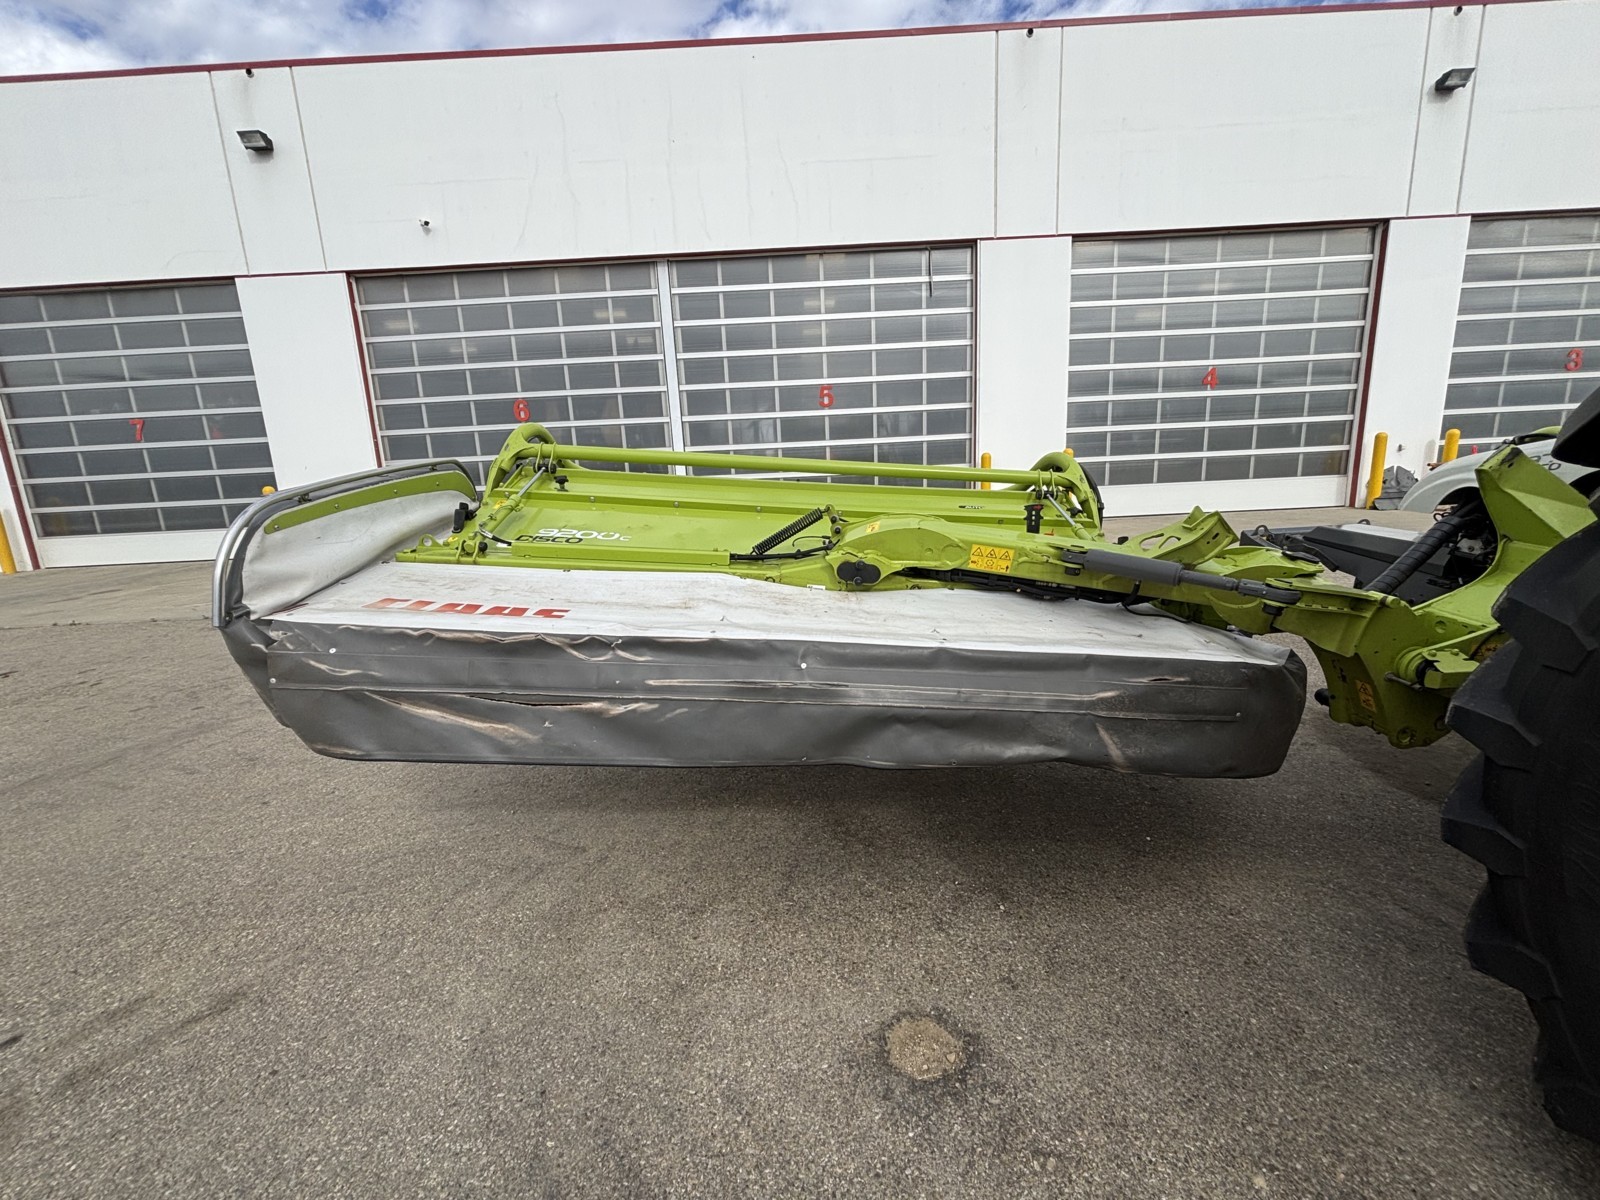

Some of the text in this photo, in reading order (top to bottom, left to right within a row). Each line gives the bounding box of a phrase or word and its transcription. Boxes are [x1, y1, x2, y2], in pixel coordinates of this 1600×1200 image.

[1564, 347, 1583, 371] 3
[1201, 366, 1218, 390] 4
[818, 384, 834, 408] 5
[513, 398, 531, 422] 6
[129, 418, 145, 442] 7
[514, 534, 584, 544] DISCO
